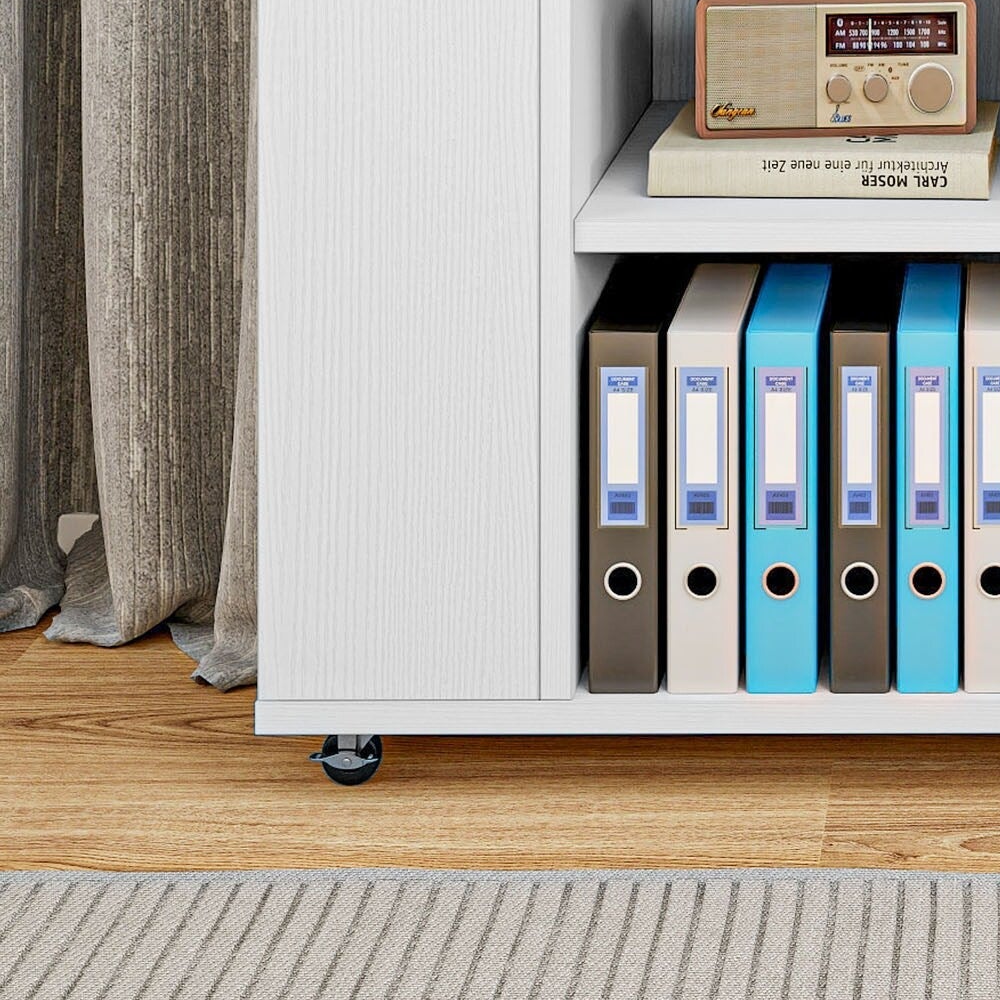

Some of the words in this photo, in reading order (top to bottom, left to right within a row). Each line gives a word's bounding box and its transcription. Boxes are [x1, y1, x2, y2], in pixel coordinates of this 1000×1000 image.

[762, 159, 786, 173] Zeit
[790, 159, 820, 170] neue
[825, 160, 851, 172] eine
[854, 160, 873, 173] für
[877, 161, 949, 174] Architektur
[861, 174, 908, 188] MOSER
[914, 175, 948, 188] CARL
